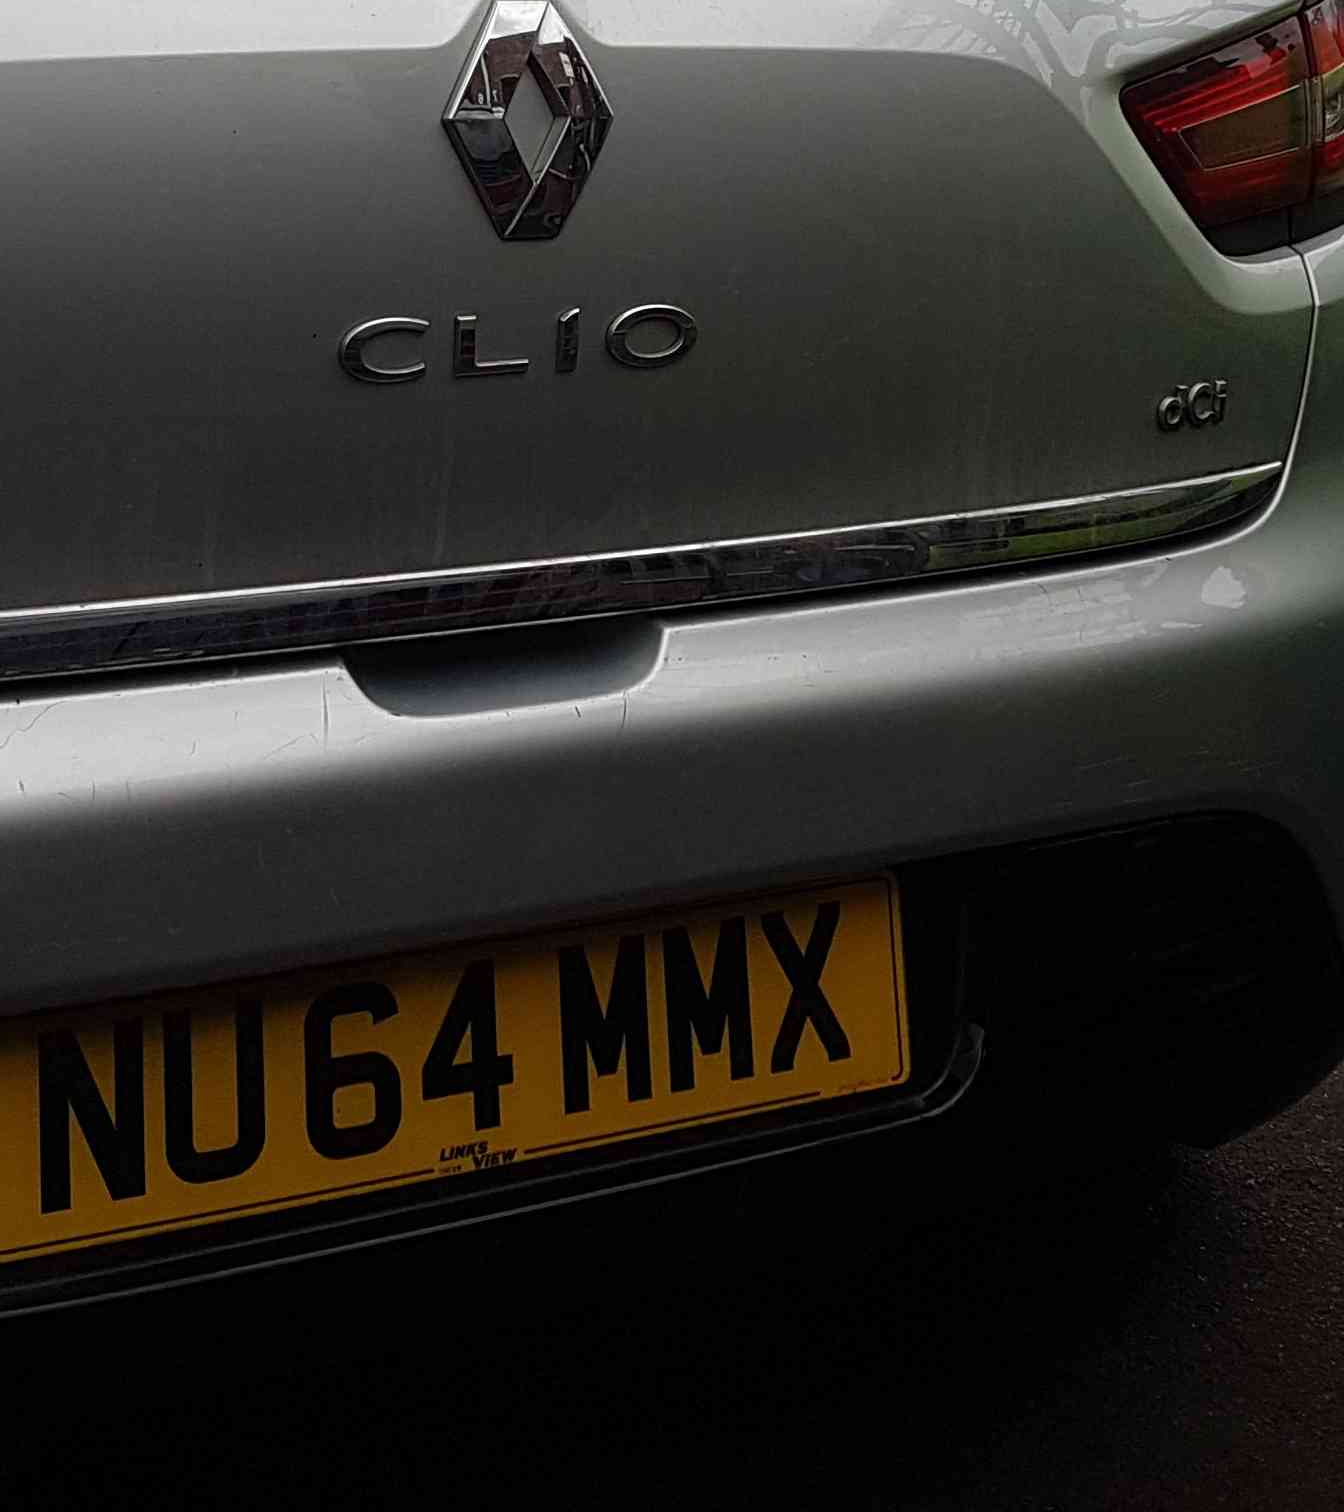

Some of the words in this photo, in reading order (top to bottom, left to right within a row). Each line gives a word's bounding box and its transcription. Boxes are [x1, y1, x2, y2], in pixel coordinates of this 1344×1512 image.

[338, 303, 698, 384] CLIO
[36, 958, 515, 1216] NU64
[556, 899, 853, 1116] MMX
[473, 1147, 518, 1169] VIEW
